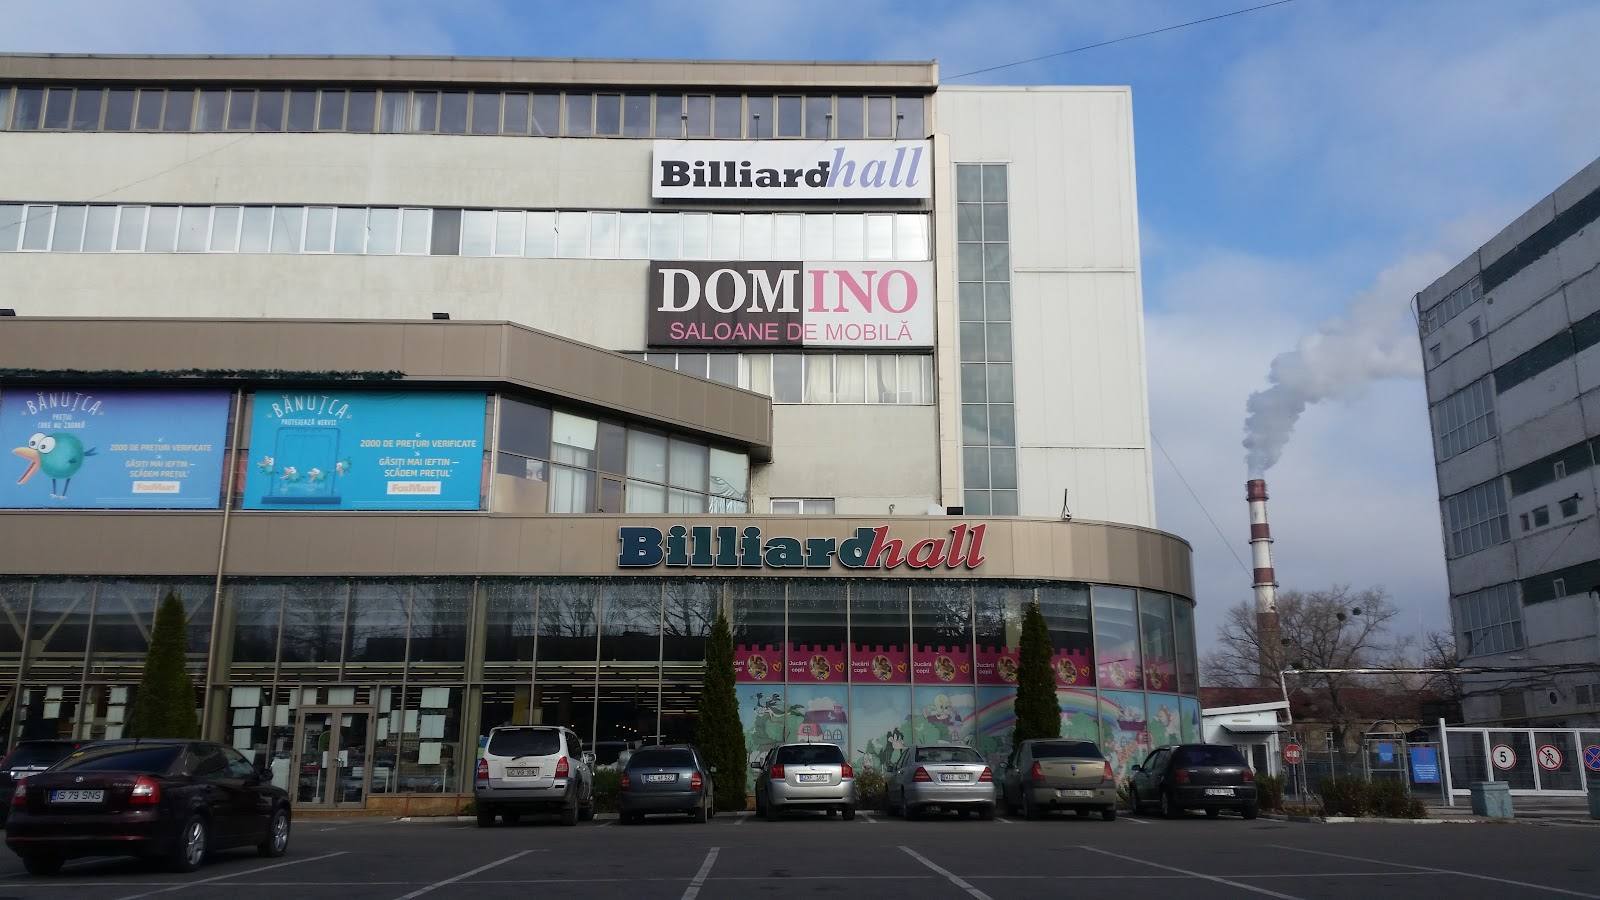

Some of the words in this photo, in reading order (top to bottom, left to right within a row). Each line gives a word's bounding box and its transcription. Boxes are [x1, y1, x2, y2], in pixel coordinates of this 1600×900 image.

[660, 147, 923, 188] Billiardhall
[657, 268, 918, 313] DOMINO
[669, 322, 778, 340] SALOANE
[787, 323, 817, 340] DE
[825, 321, 912, 340] MOBILĂ
[360, 439, 381, 448] 2000
[383, 440, 393, 448] DE
[432, 440, 477, 448] VERIFICATE
[617, 523, 988, 569] Billiardhall
[1500, 751, 1507, 763] 5
